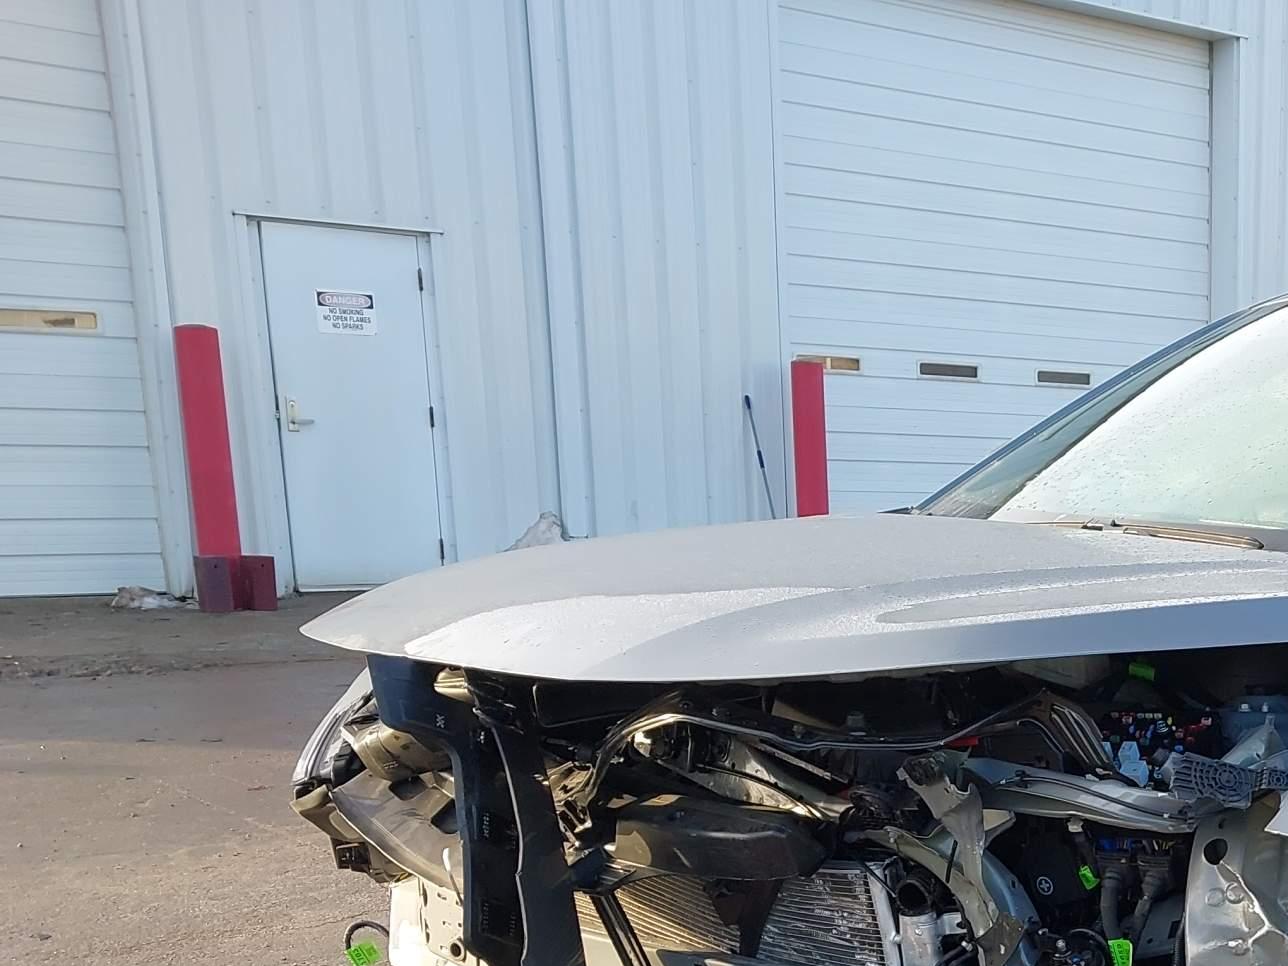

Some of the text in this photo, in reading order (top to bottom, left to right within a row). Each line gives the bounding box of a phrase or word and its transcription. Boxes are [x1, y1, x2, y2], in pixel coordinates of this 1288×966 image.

[325, 295, 365, 305] DANGER
[339, 308, 364, 316] SMOKING
[349, 315, 371, 324] FLAMES
[341, 322, 364, 331] SPARKS
